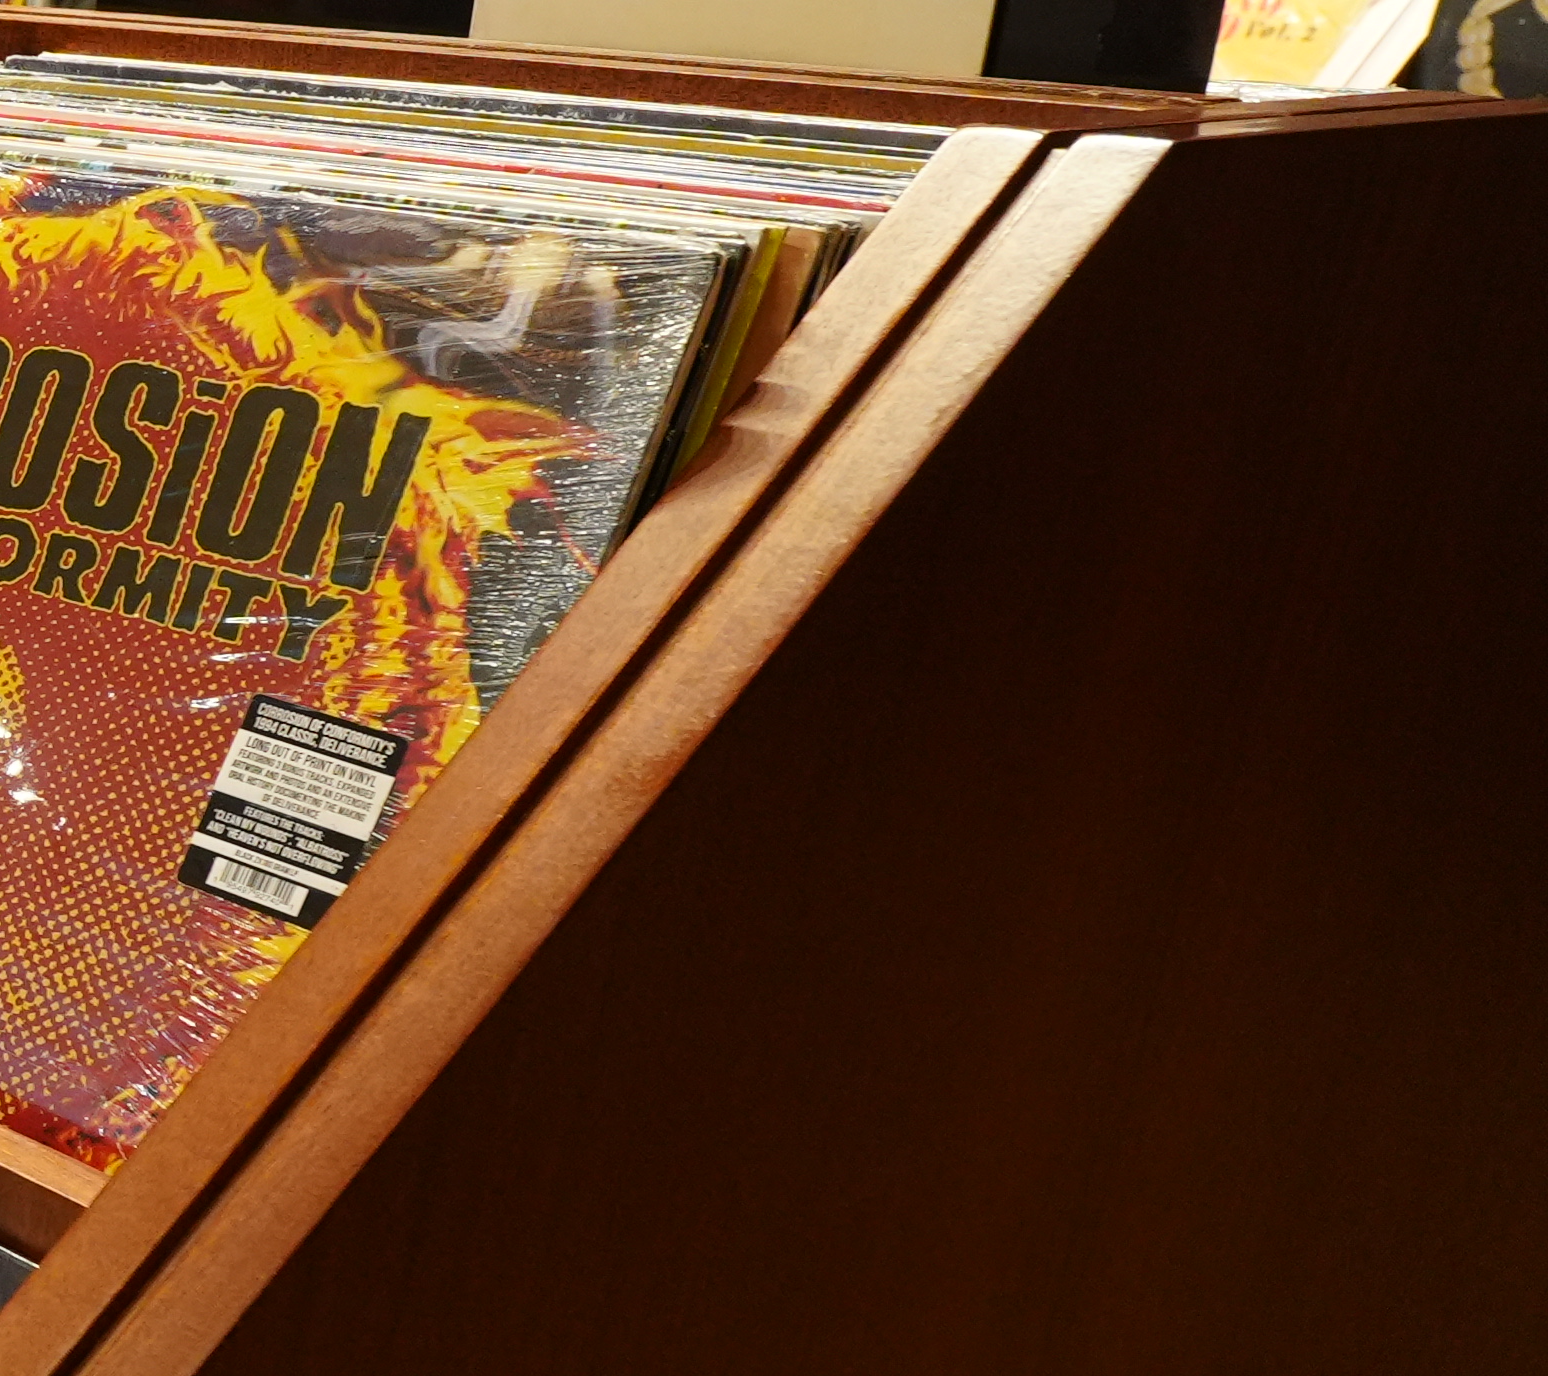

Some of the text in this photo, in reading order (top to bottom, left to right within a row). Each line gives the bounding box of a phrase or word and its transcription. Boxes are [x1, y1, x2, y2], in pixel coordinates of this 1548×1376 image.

[254, 716, 277, 733] 1994
[257, 703, 397, 756] CORROSION OF CONFORMITY'S
[246, 736, 377, 788] LONG OUT OF PRINT ON VINYL
